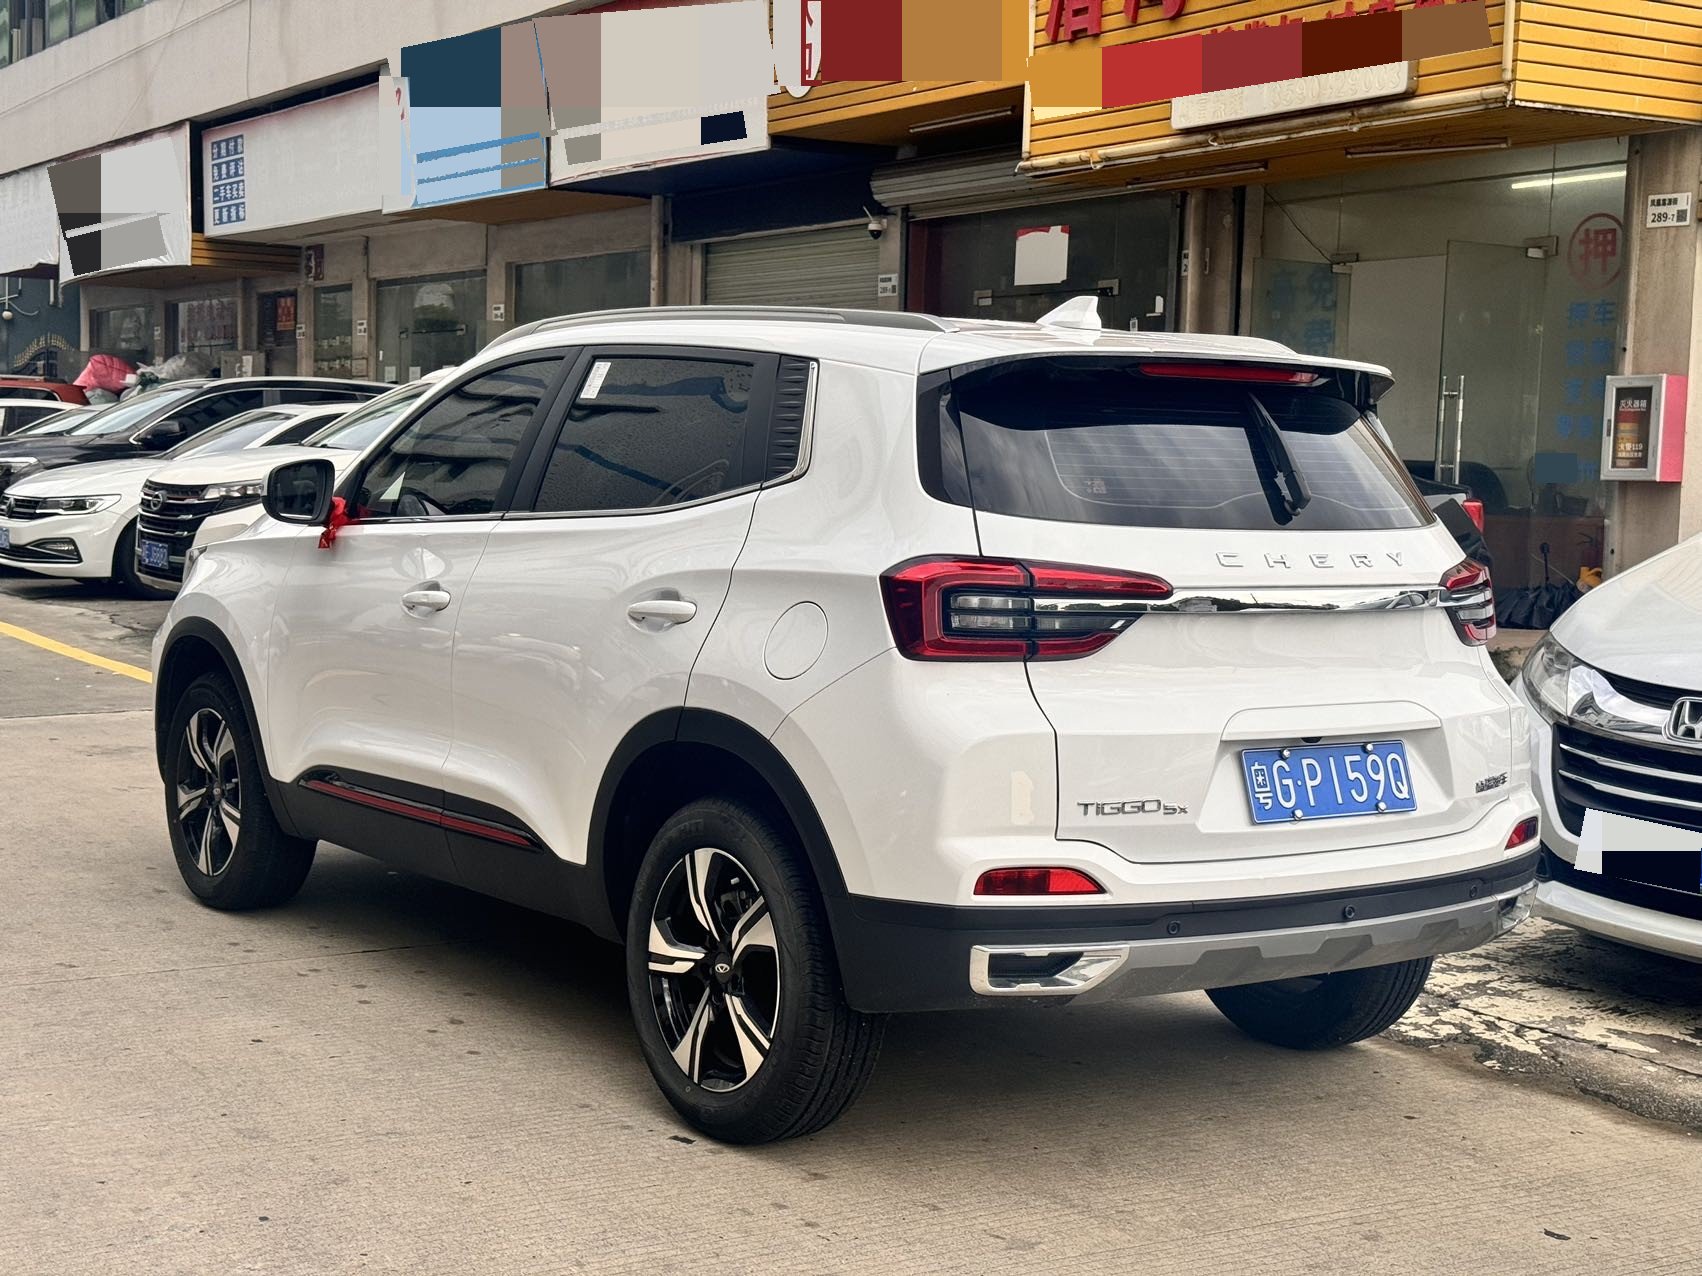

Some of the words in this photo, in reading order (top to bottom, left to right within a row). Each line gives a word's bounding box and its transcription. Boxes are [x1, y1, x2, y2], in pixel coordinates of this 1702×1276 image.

[213, 182, 245, 201] 二手车买卖
[1651, 212, 1675, 223] 289-7
[1578, 228, 1617, 273] 押
[1619, 399, 1648, 409] 灭火器箱
[1215, 551, 1404, 569] CHERY
